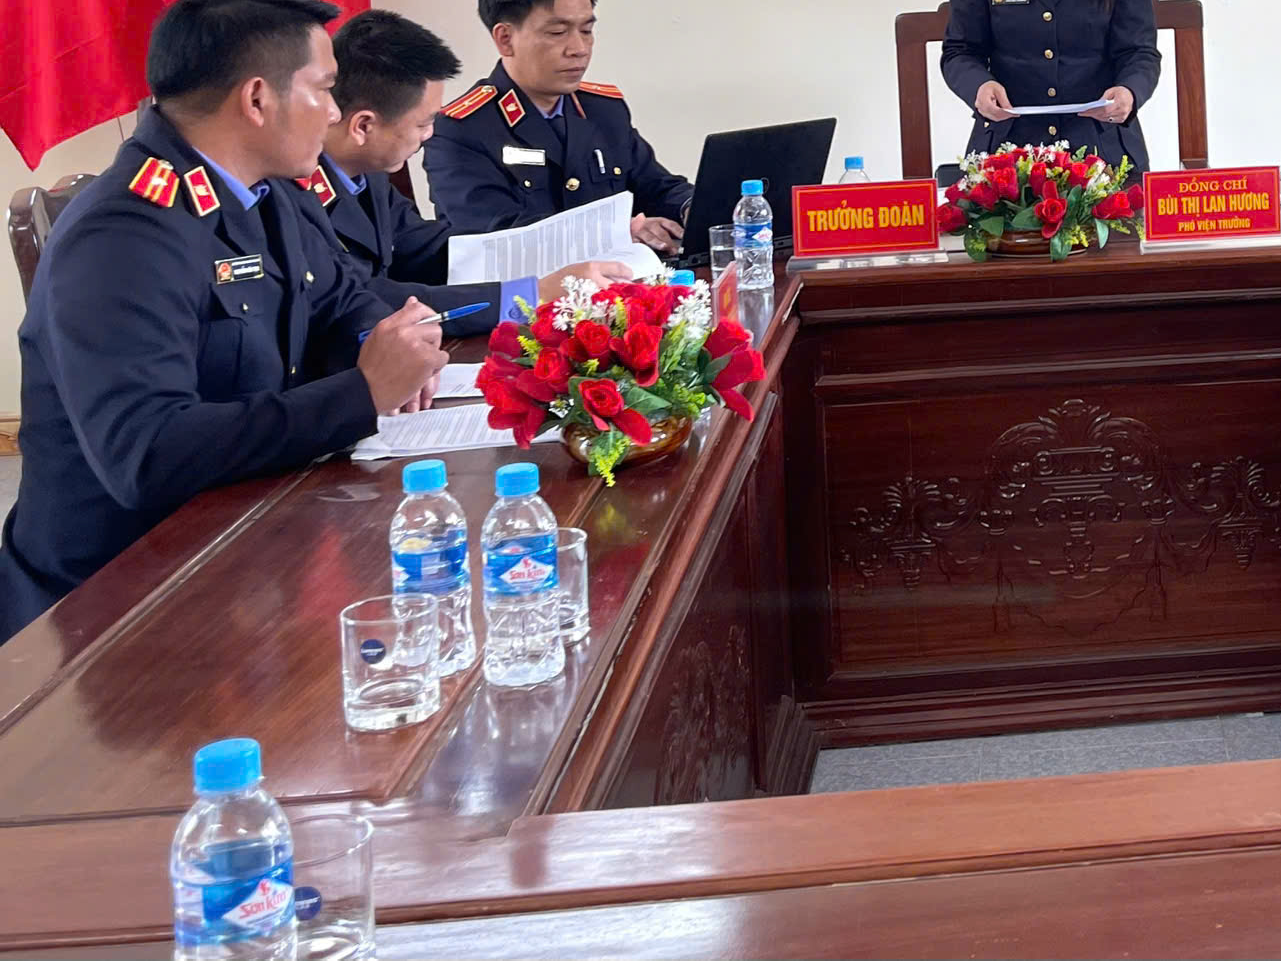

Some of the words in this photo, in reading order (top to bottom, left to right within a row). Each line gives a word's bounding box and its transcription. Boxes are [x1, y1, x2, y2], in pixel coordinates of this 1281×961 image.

[1178, 177, 1220, 193] ĐỒNG
[1223, 176, 1248, 191] CHÍ
[1158, 194, 1179, 216] BÙI
[1181, 196, 1200, 217] THỊ
[1203, 194, 1226, 213] LAN
[1229, 192, 1270, 212] HƯƠNG
[807, 199, 874, 232] TRƯỞNG
[878, 200, 925, 228] ĐOÀN
[1178, 219, 1195, 232] PHÓ
[1197, 219, 1217, 232] VIỆN
